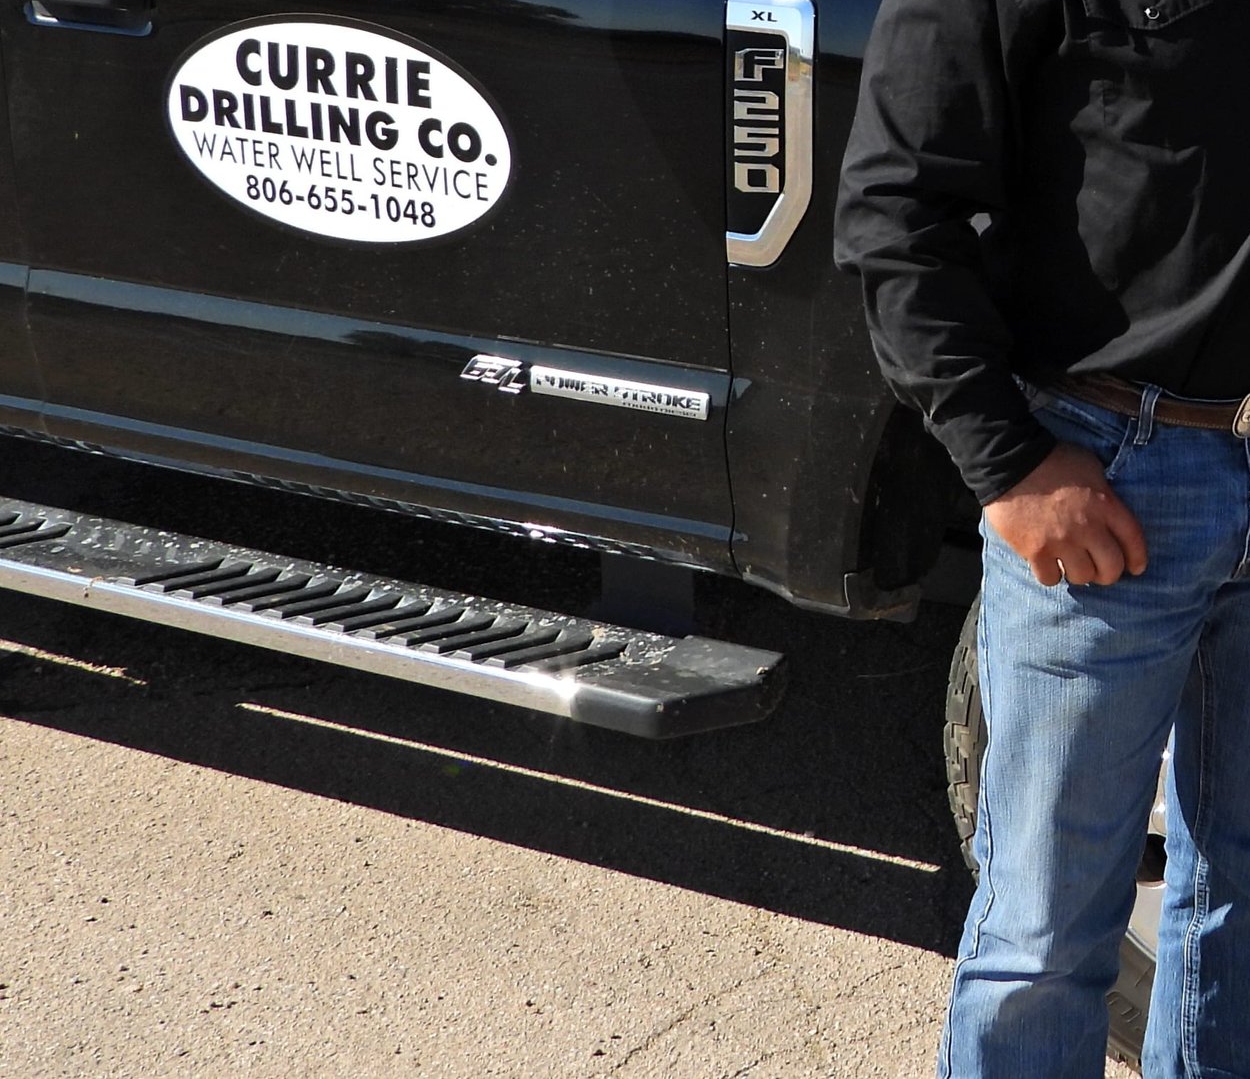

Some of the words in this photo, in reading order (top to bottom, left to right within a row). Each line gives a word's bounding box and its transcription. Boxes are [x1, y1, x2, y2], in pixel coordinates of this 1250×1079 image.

[751, 10, 778, 22] XL
[236, 38, 432, 109] CURRIE
[179, 84, 399, 151] DRILLING
[418, 118, 498, 167] CO.
[192, 130, 282, 170] WATER
[291, 144, 362, 183] WELL
[373, 157, 489, 202] SERVICE
[246, 174, 436, 228] 806-655-1048
[613, 385, 703, 412] STROKE
